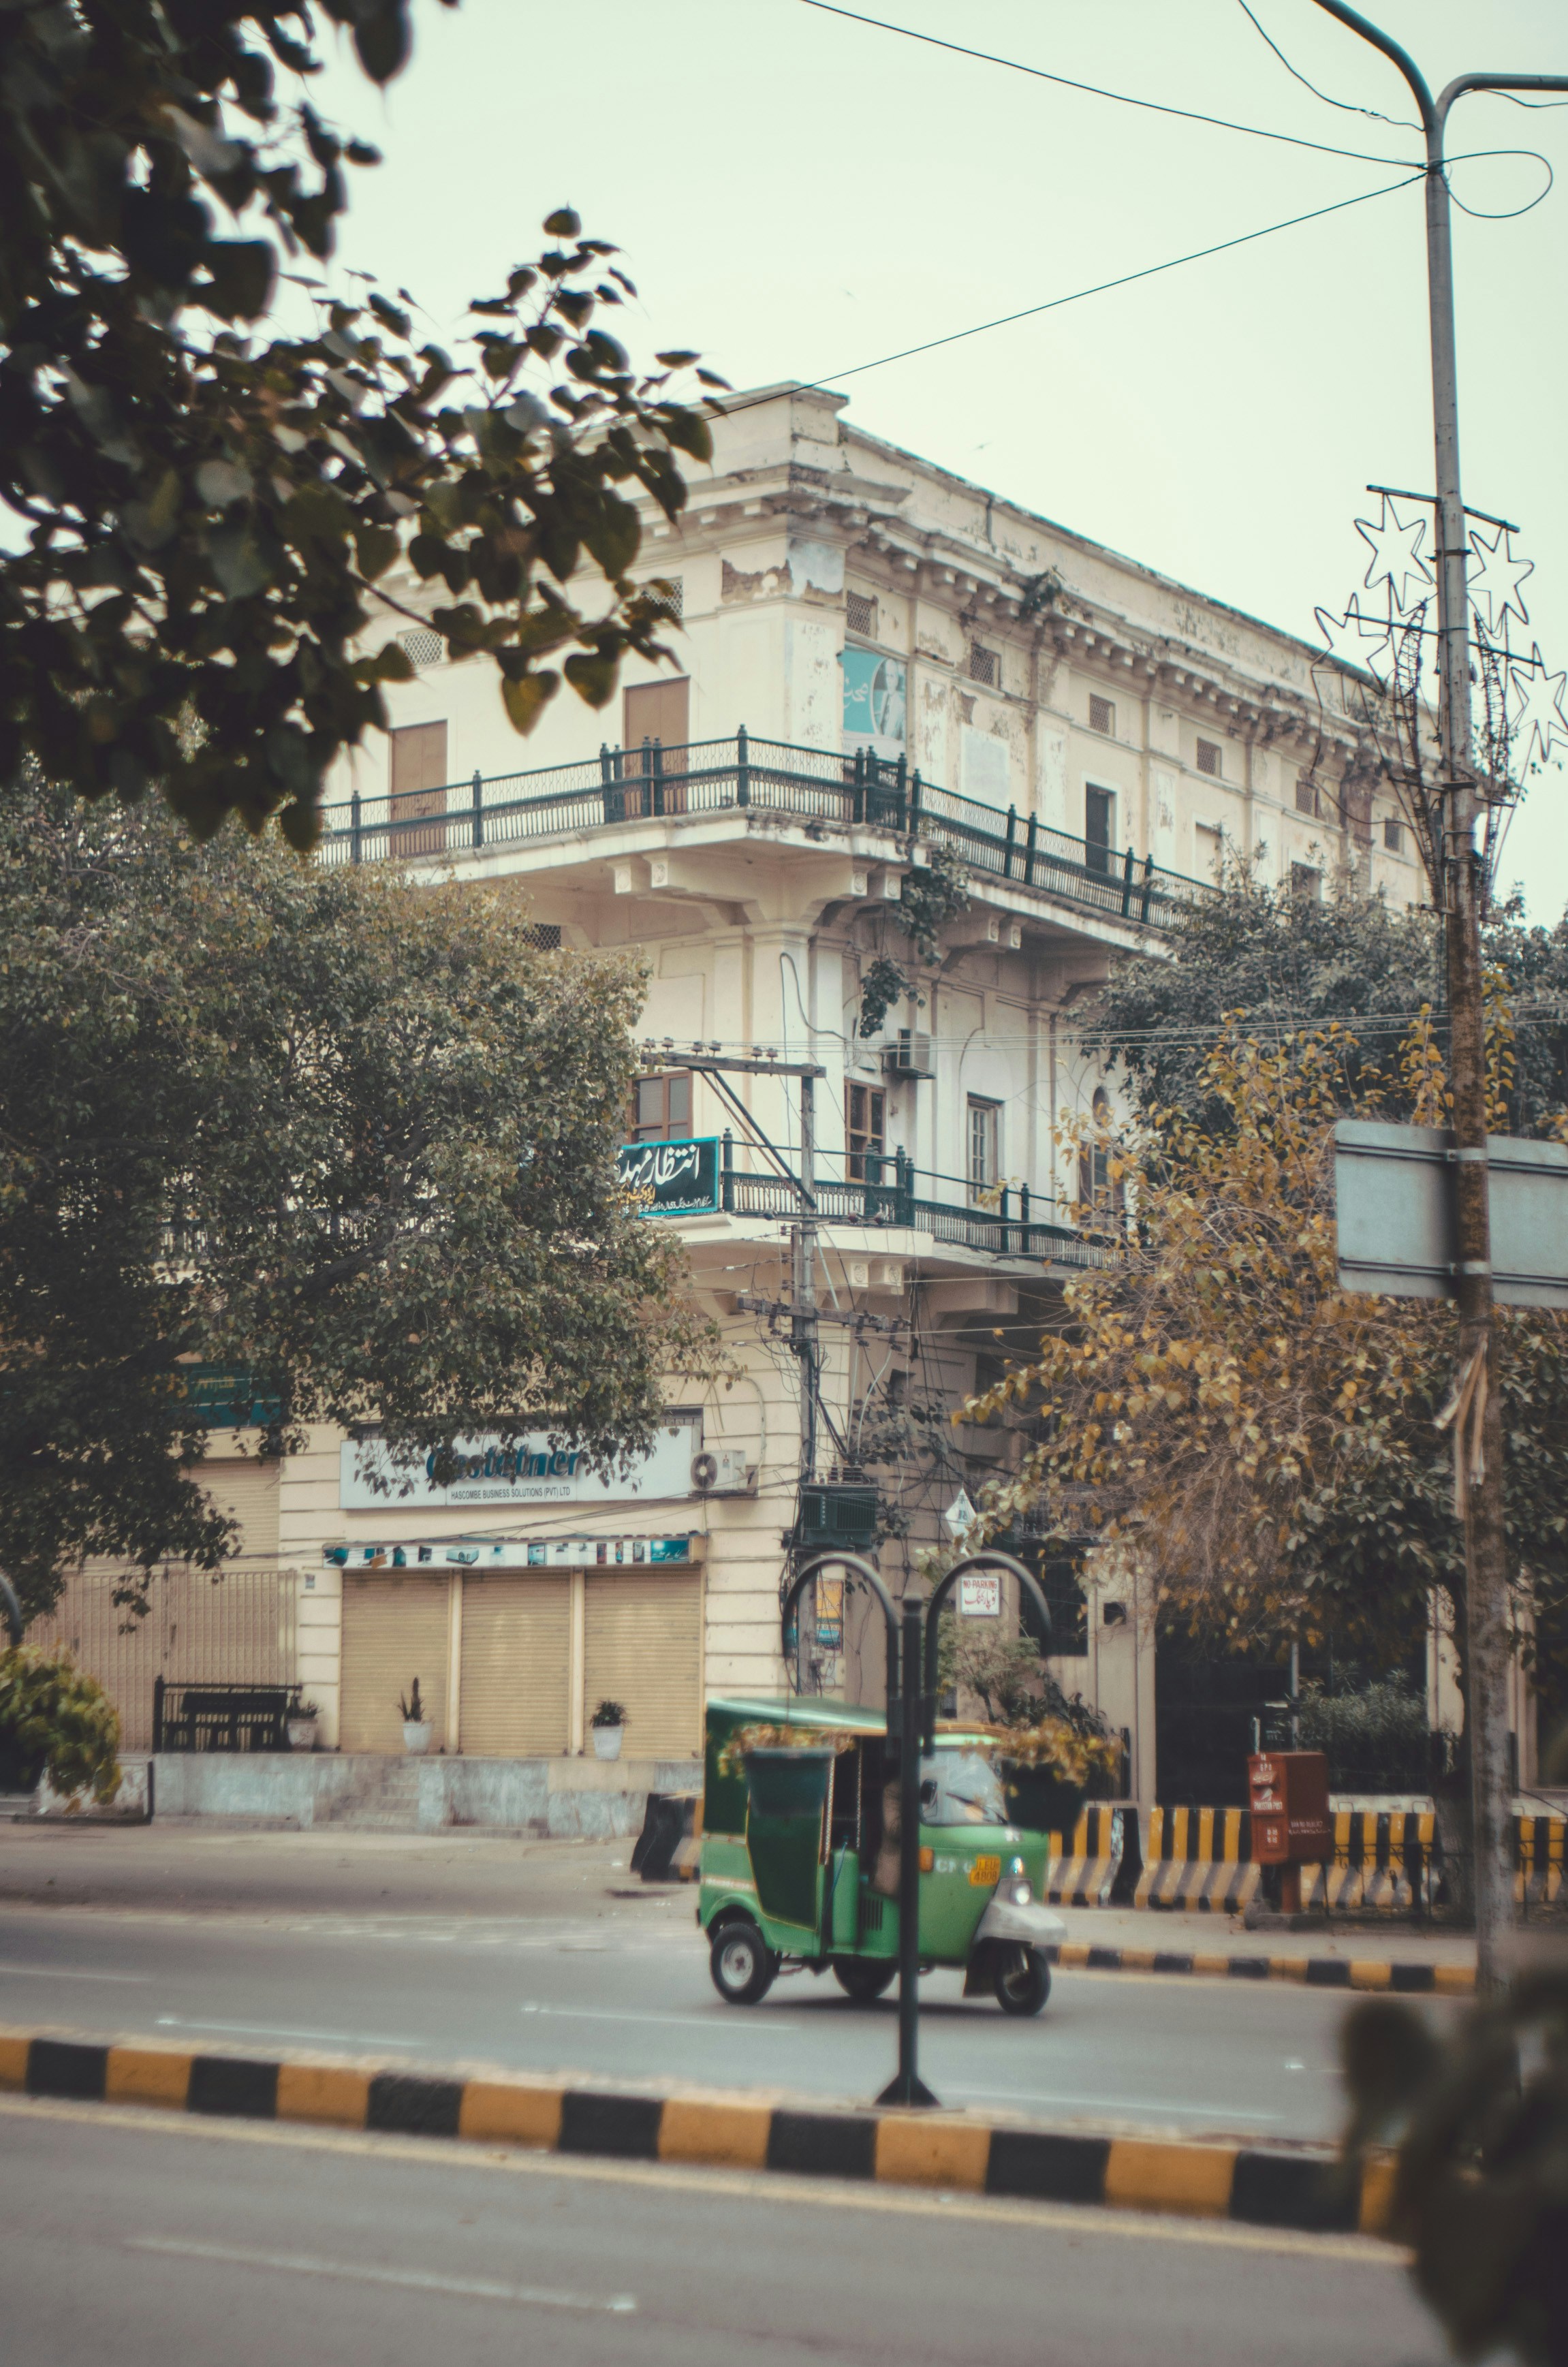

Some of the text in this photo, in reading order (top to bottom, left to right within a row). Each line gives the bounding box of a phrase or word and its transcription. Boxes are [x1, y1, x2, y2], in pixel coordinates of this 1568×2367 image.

[642, 1144, 700, 1185] انتظار
[451, 1486, 571, 1501] HASCOMBE BUSINESS SOLUTIONS (PVT) LTD
[963, 1580, 997, 1589] NO PARKING
[1253, 1801, 1283, 1810] PAKISTAN POST
[974, 1870, 997, 1882] 4808
